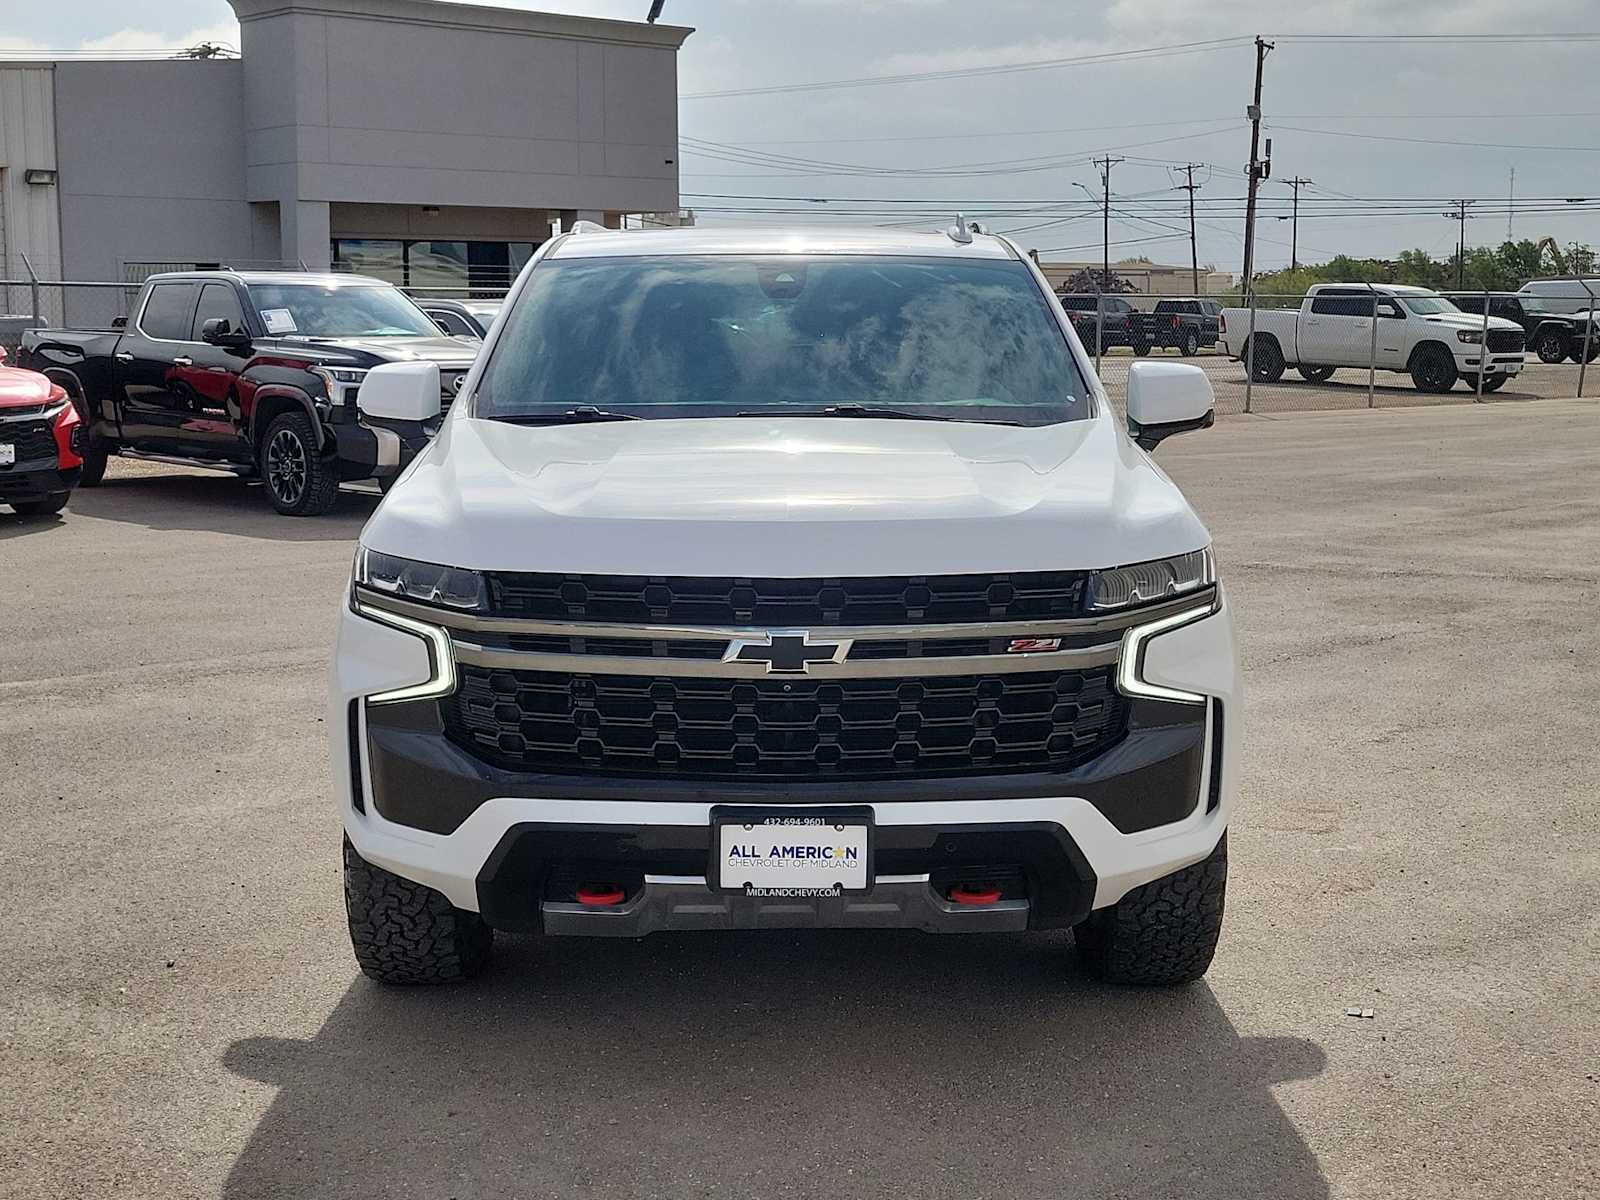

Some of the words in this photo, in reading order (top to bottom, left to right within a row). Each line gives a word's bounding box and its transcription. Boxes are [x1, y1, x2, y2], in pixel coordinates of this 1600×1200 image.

[1007, 638, 1062, 652] Z71
[763, 817, 826, 826] 432-694-9601
[729, 845, 760, 858] ALL
[728, 858, 789, 868] CHEVROLET
[792, 859, 807, 868] OF
[810, 859, 858, 869] MIDLAND
[746, 888, 841, 897] MIDLANDCHEVY.COM
